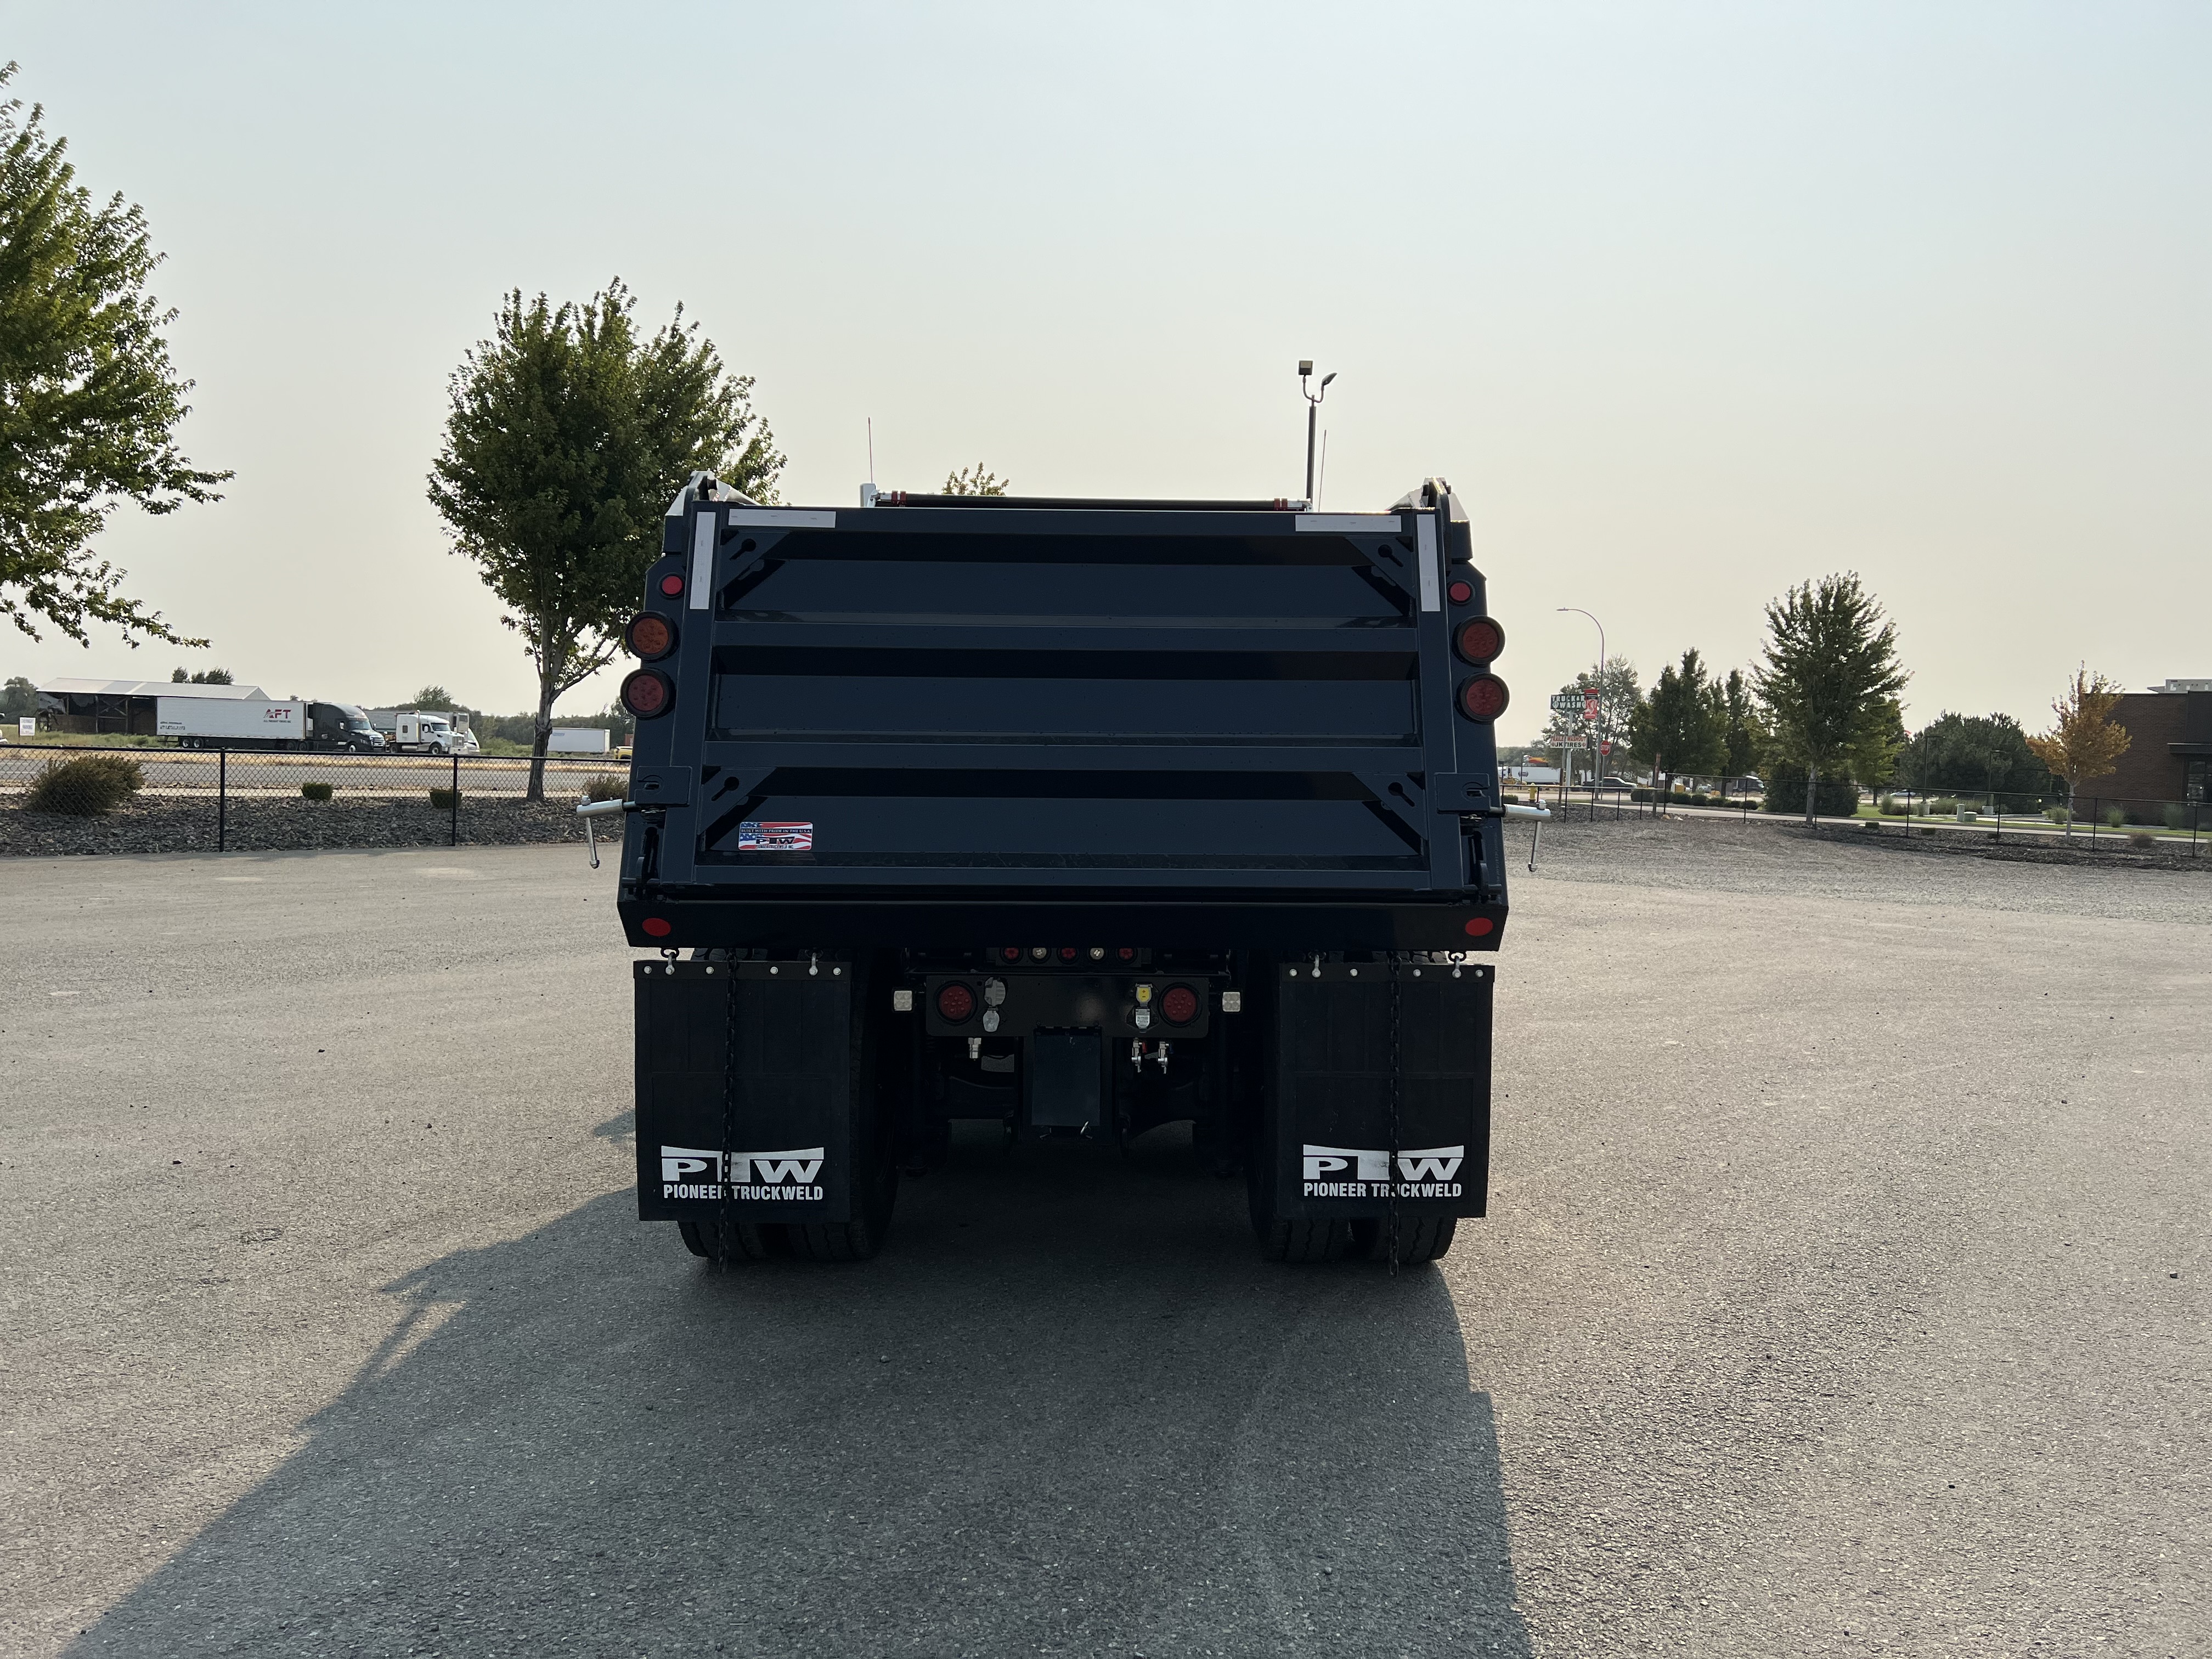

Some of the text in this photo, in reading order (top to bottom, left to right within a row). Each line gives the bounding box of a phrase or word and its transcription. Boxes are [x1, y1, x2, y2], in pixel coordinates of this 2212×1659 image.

[263, 709, 291, 719] AFT
[661, 1146, 824, 1183] PTW
[1304, 1144, 1464, 1180] PTW
[664, 1184, 823, 1200] PIONEER TRUCKWELD
[1304, 1183, 1366, 1197] PIONEER
